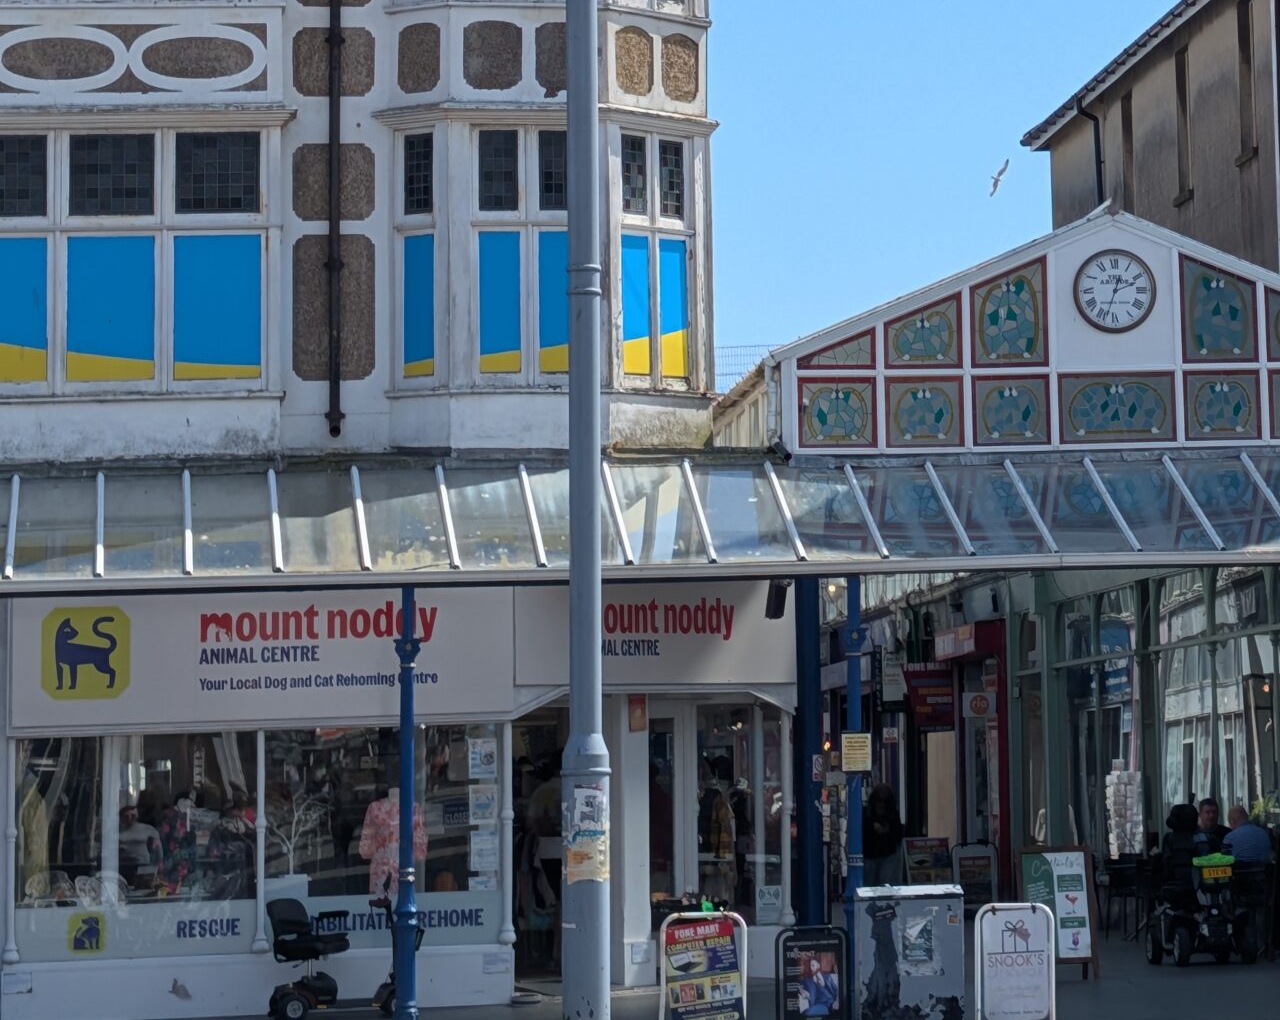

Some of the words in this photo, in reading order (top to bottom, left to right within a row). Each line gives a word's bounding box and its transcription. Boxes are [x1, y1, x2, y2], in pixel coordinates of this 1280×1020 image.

[200, 604, 319, 643] mount
[603, 597, 659, 634] ount
[663, 597, 735, 641] noddy
[199, 646, 258, 665] ANIMAL
[261, 645, 320, 663] CENTRE
[621, 639, 660, 656] CENTRE
[199, 677, 228, 691] Your
[230, 676, 262, 691] Local
[264, 676, 287, 691] Dog
[289, 674, 312, 688] and
[314, 674, 334, 688] Cat
[336, 671, 396, 688] Rehoming
[416, 908, 484, 928] REHOME
[176, 918, 240, 939] RESCUE
[988, 953, 1044, 969] SNOOK'S
